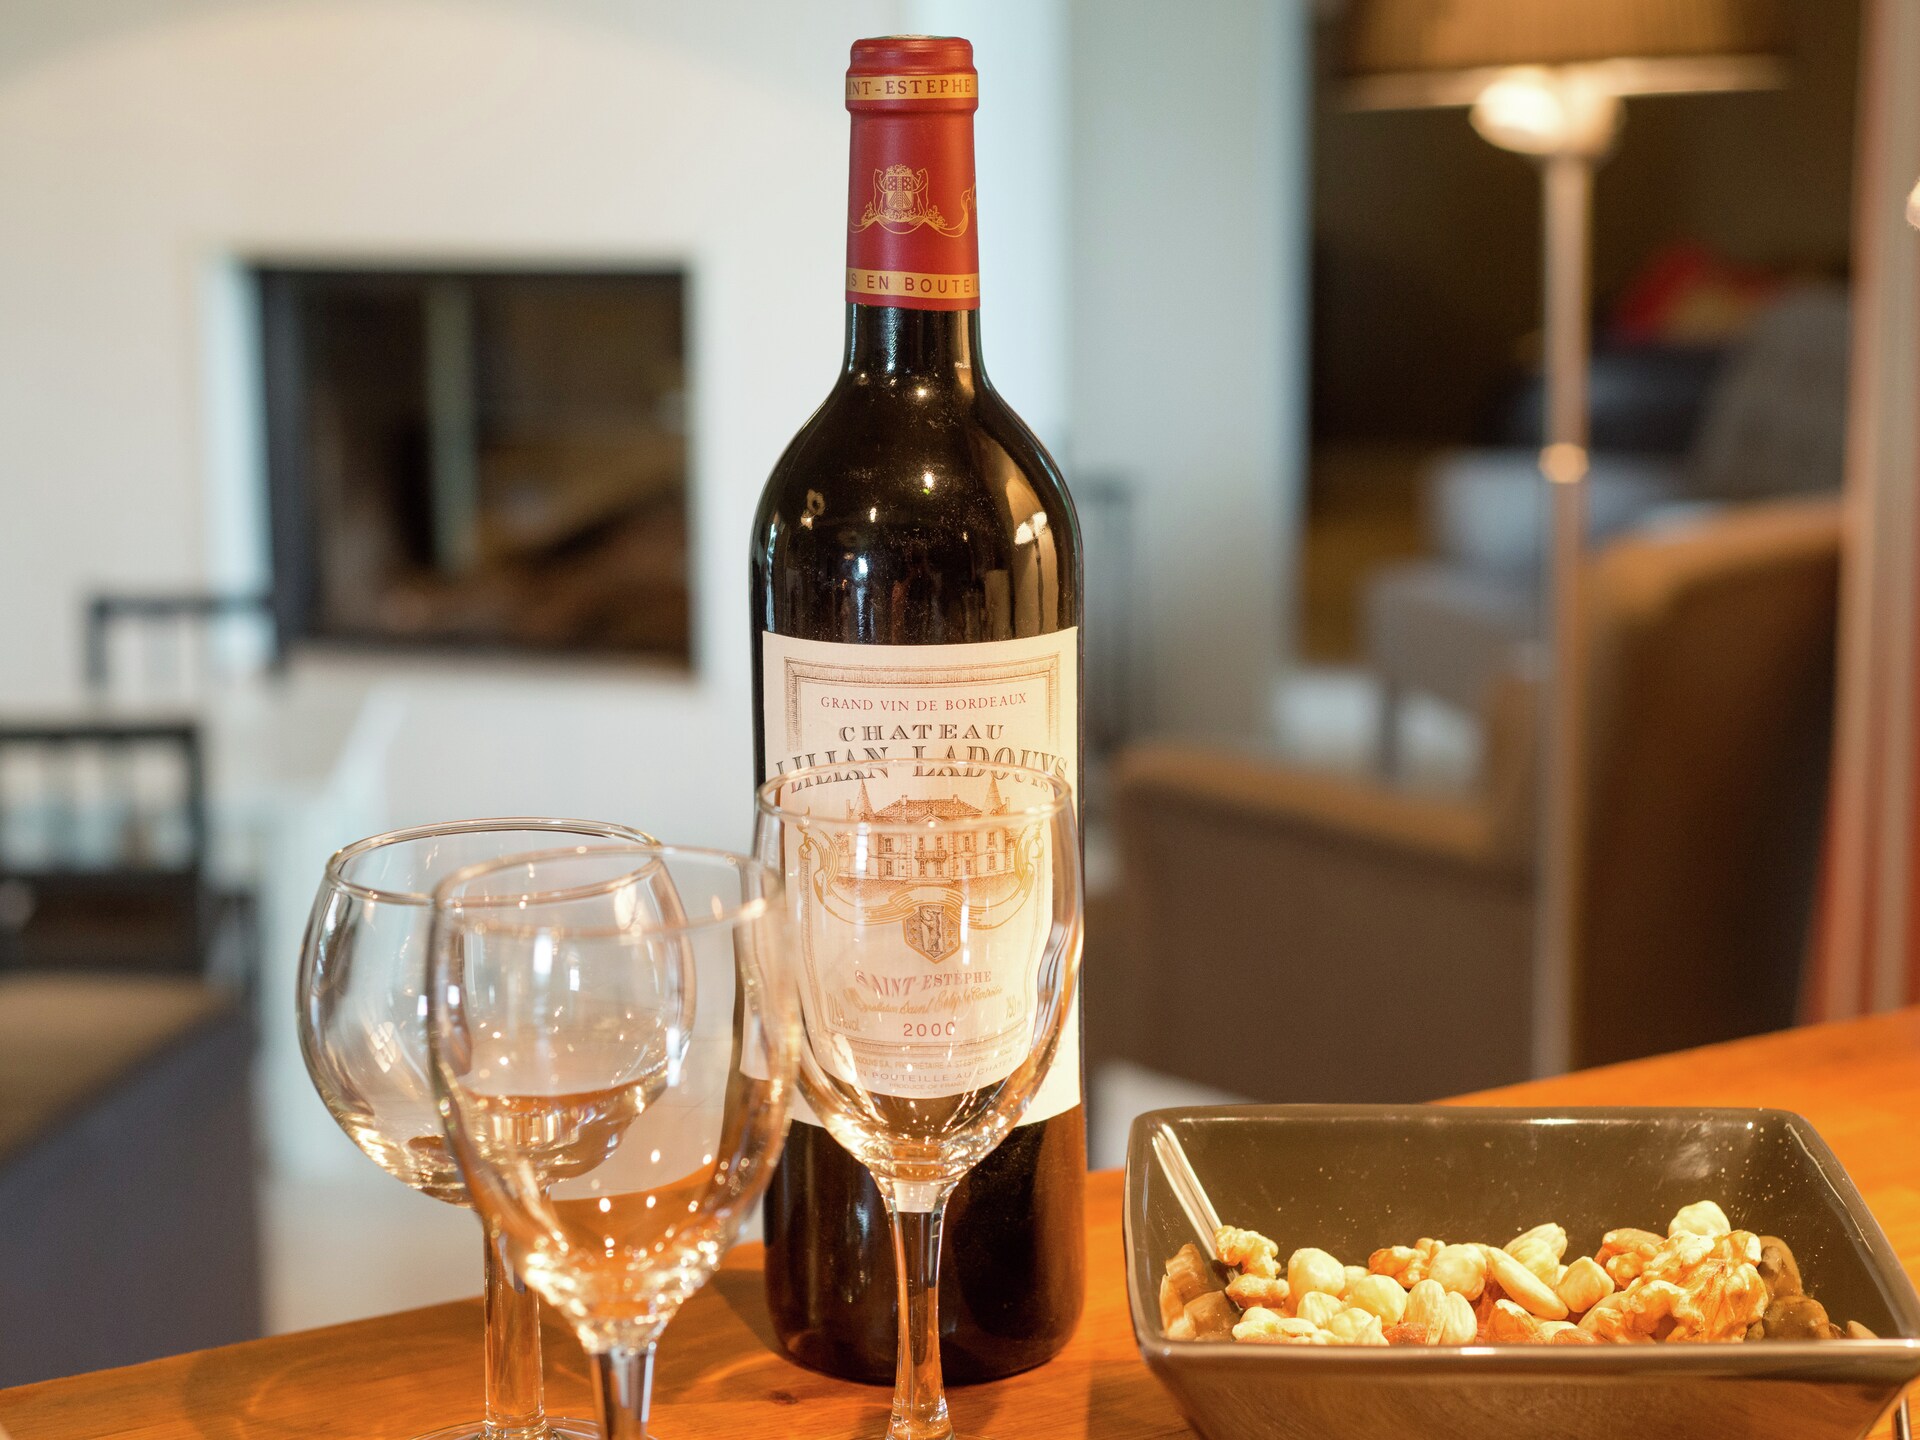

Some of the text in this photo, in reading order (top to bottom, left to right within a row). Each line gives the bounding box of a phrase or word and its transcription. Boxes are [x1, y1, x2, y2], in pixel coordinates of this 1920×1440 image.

[866, 274, 889, 290] EN
[820, 692, 1027, 712] GRAND VIN DE BORDEAUX
[838, 723, 1005, 743] CHATEAU
[903, 1021, 956, 1037] 2000
[955, 1071, 973, 1080] AU
